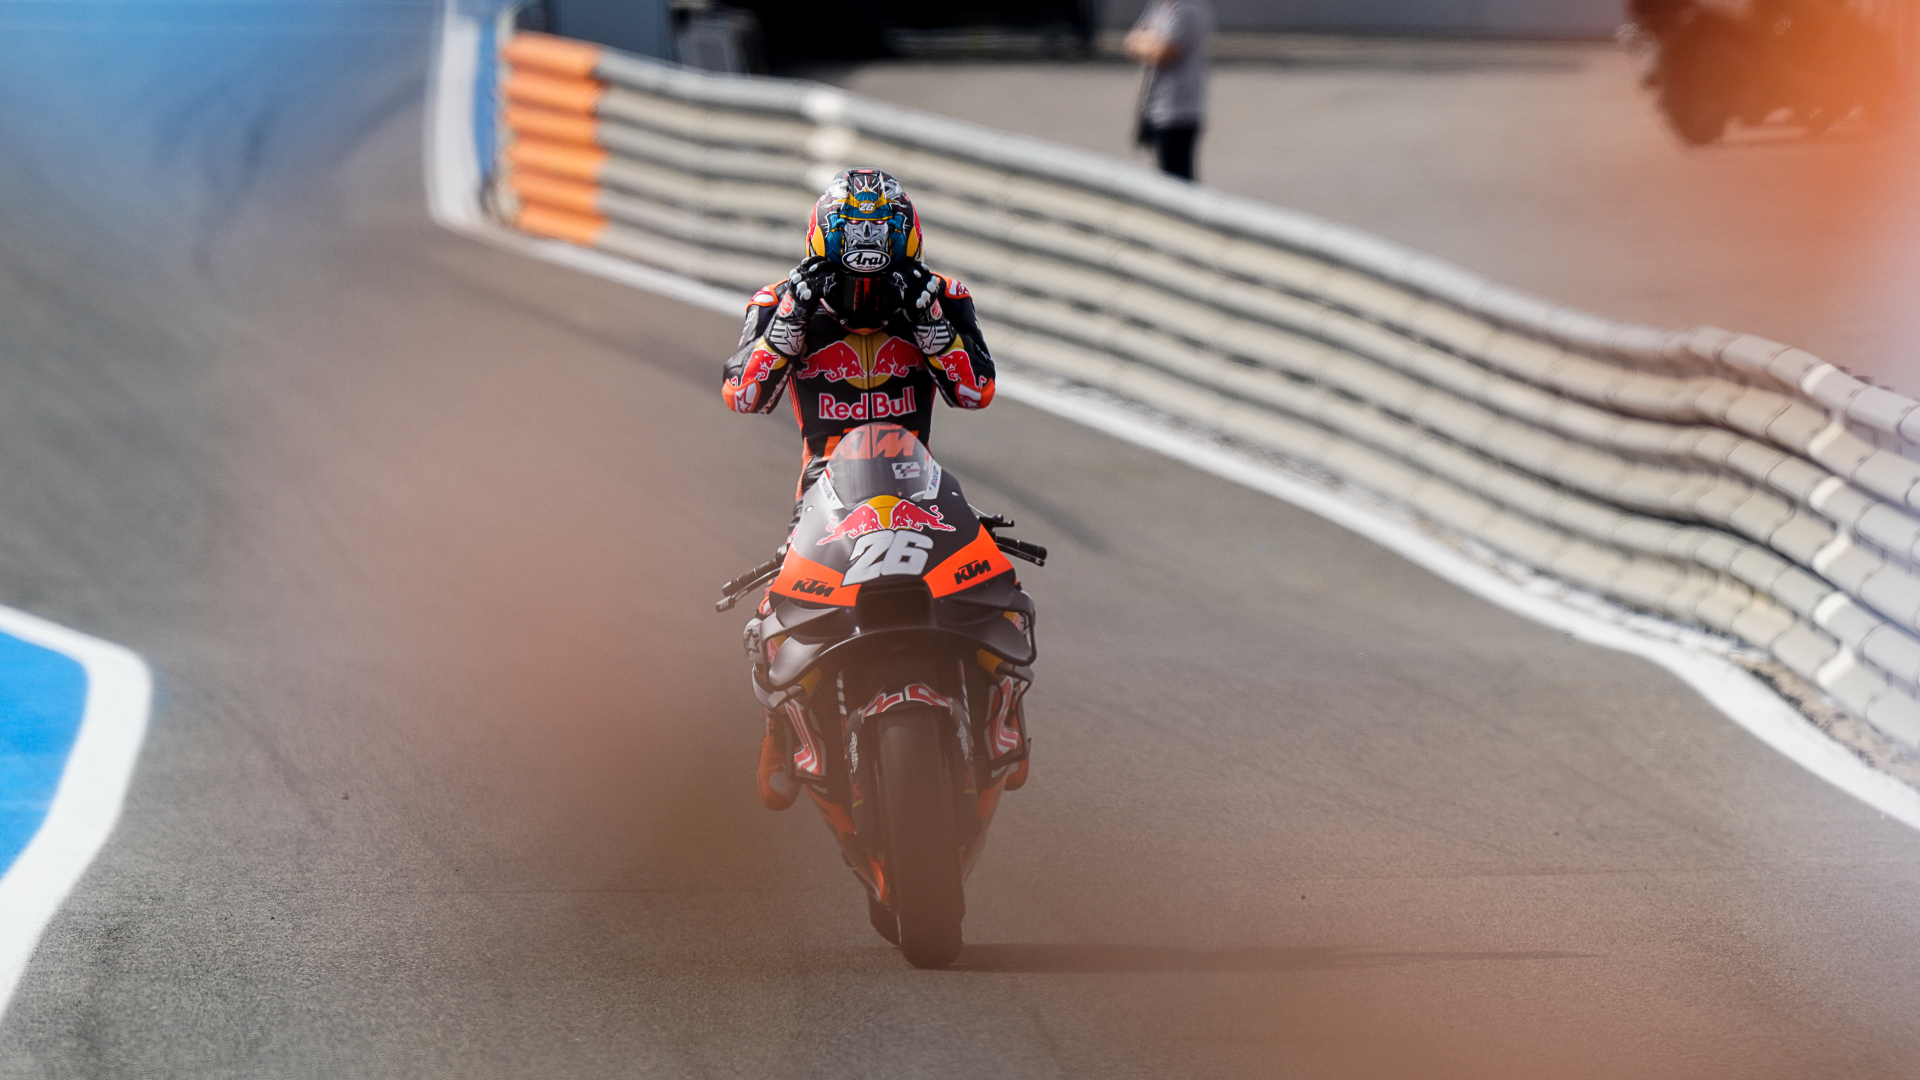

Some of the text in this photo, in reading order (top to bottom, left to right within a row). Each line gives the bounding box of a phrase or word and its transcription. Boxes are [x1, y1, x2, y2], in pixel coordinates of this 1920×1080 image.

[859, 203, 875, 211] 26
[847, 252, 885, 266] Arai
[819, 386, 916, 419] Red Bull
[821, 425, 919, 461] KTM
[841, 529, 933, 587] 26
[954, 560, 991, 585] KTM
[791, 578, 835, 598] KTM
